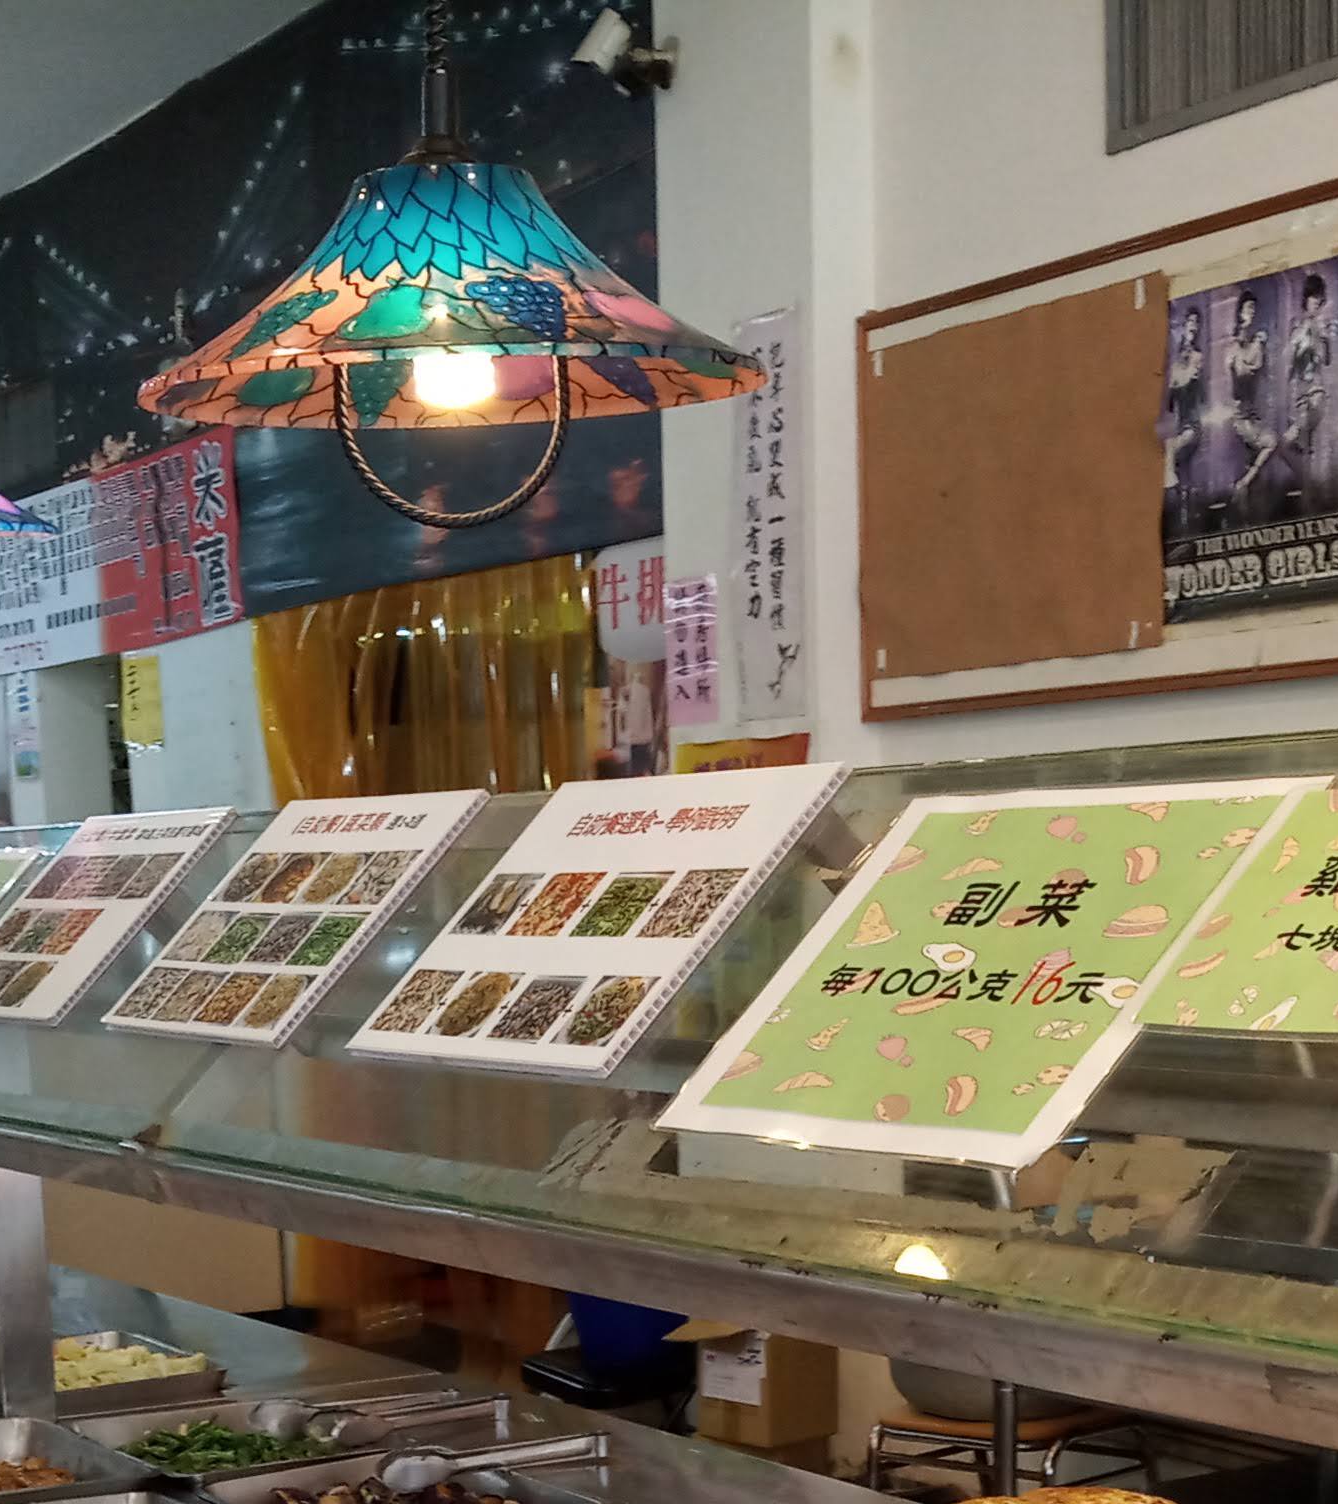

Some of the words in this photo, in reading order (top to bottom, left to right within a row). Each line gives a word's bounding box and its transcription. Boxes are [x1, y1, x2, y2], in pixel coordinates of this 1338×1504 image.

[1196, 539, 1224, 557] THE
[597, 556, 666, 630] 牛排
[943, 878, 1098, 928] 副菜
[820, 959, 1106, 1006] 每100公克16元
